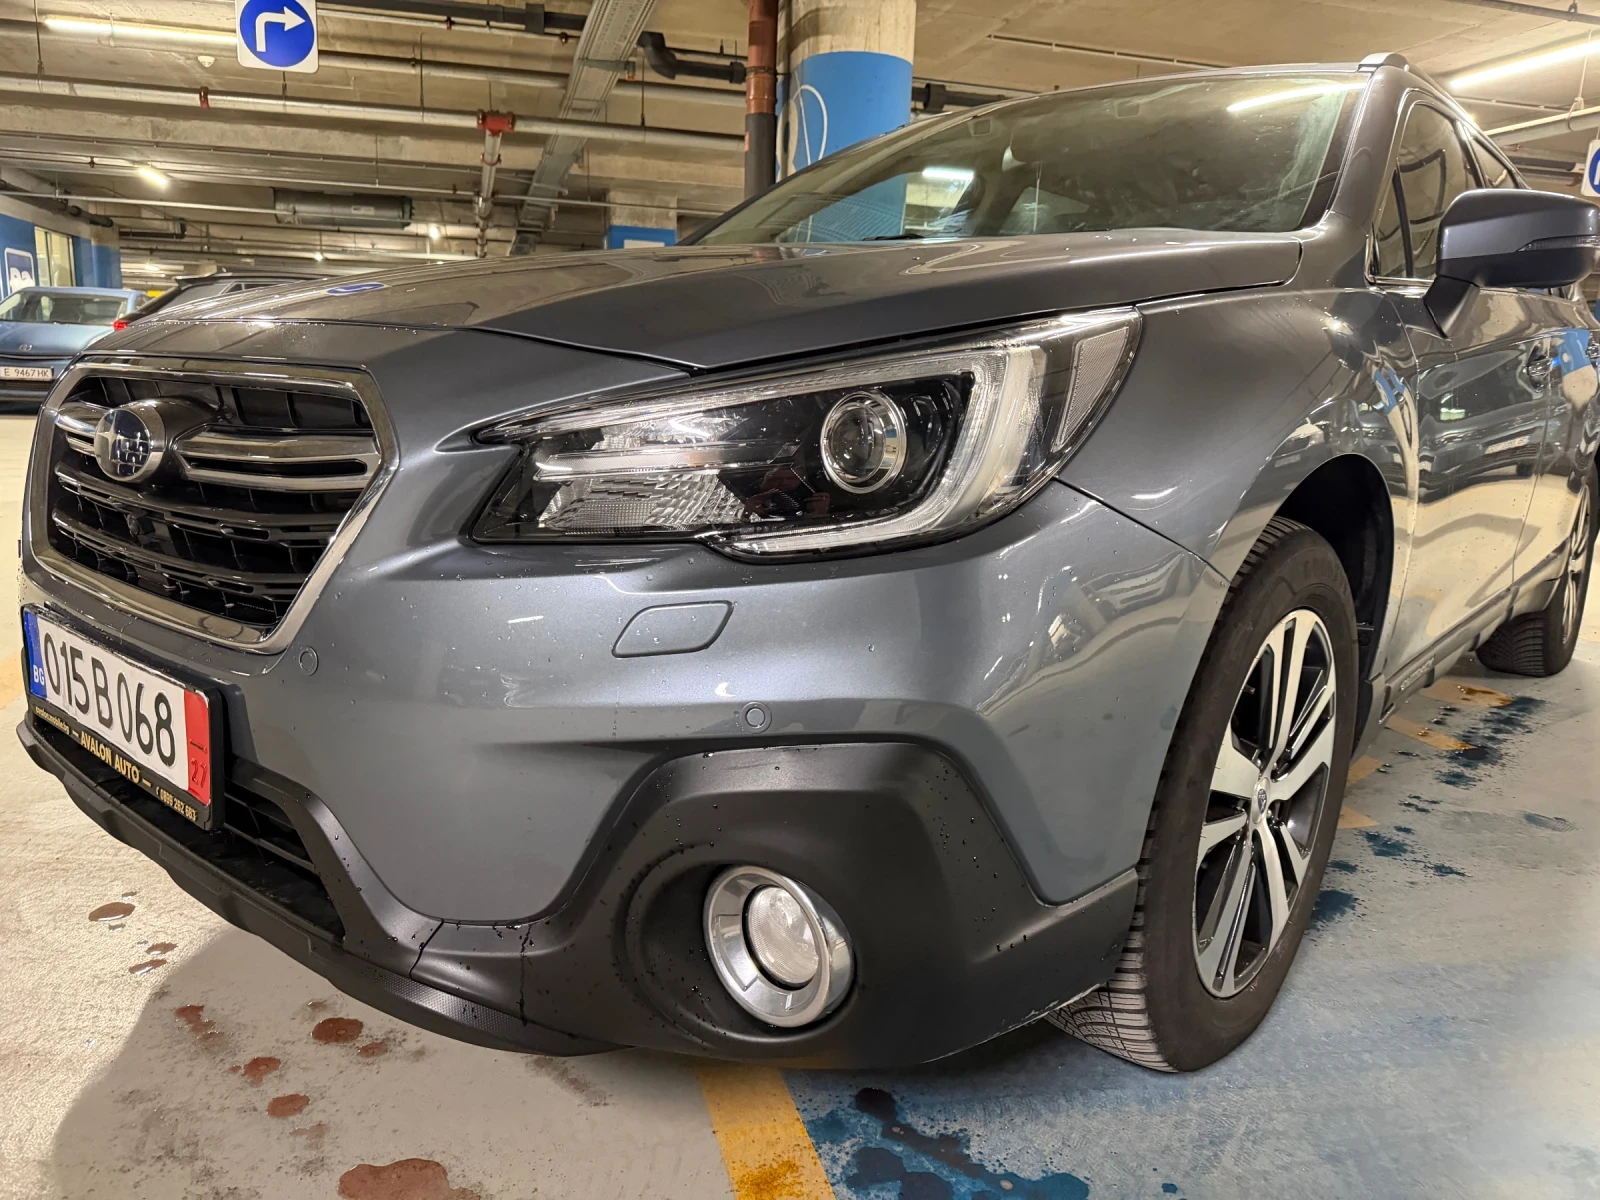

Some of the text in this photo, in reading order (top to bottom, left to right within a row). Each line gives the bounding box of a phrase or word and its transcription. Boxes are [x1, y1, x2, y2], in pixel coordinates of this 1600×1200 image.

[4, 368, 49, 378] E 9467 HK
[33, 664, 44, 686] BG
[81, 731, 112, 766] AVALON
[115, 754, 140, 784] AUTO
[191, 758, 207, 789] 27
